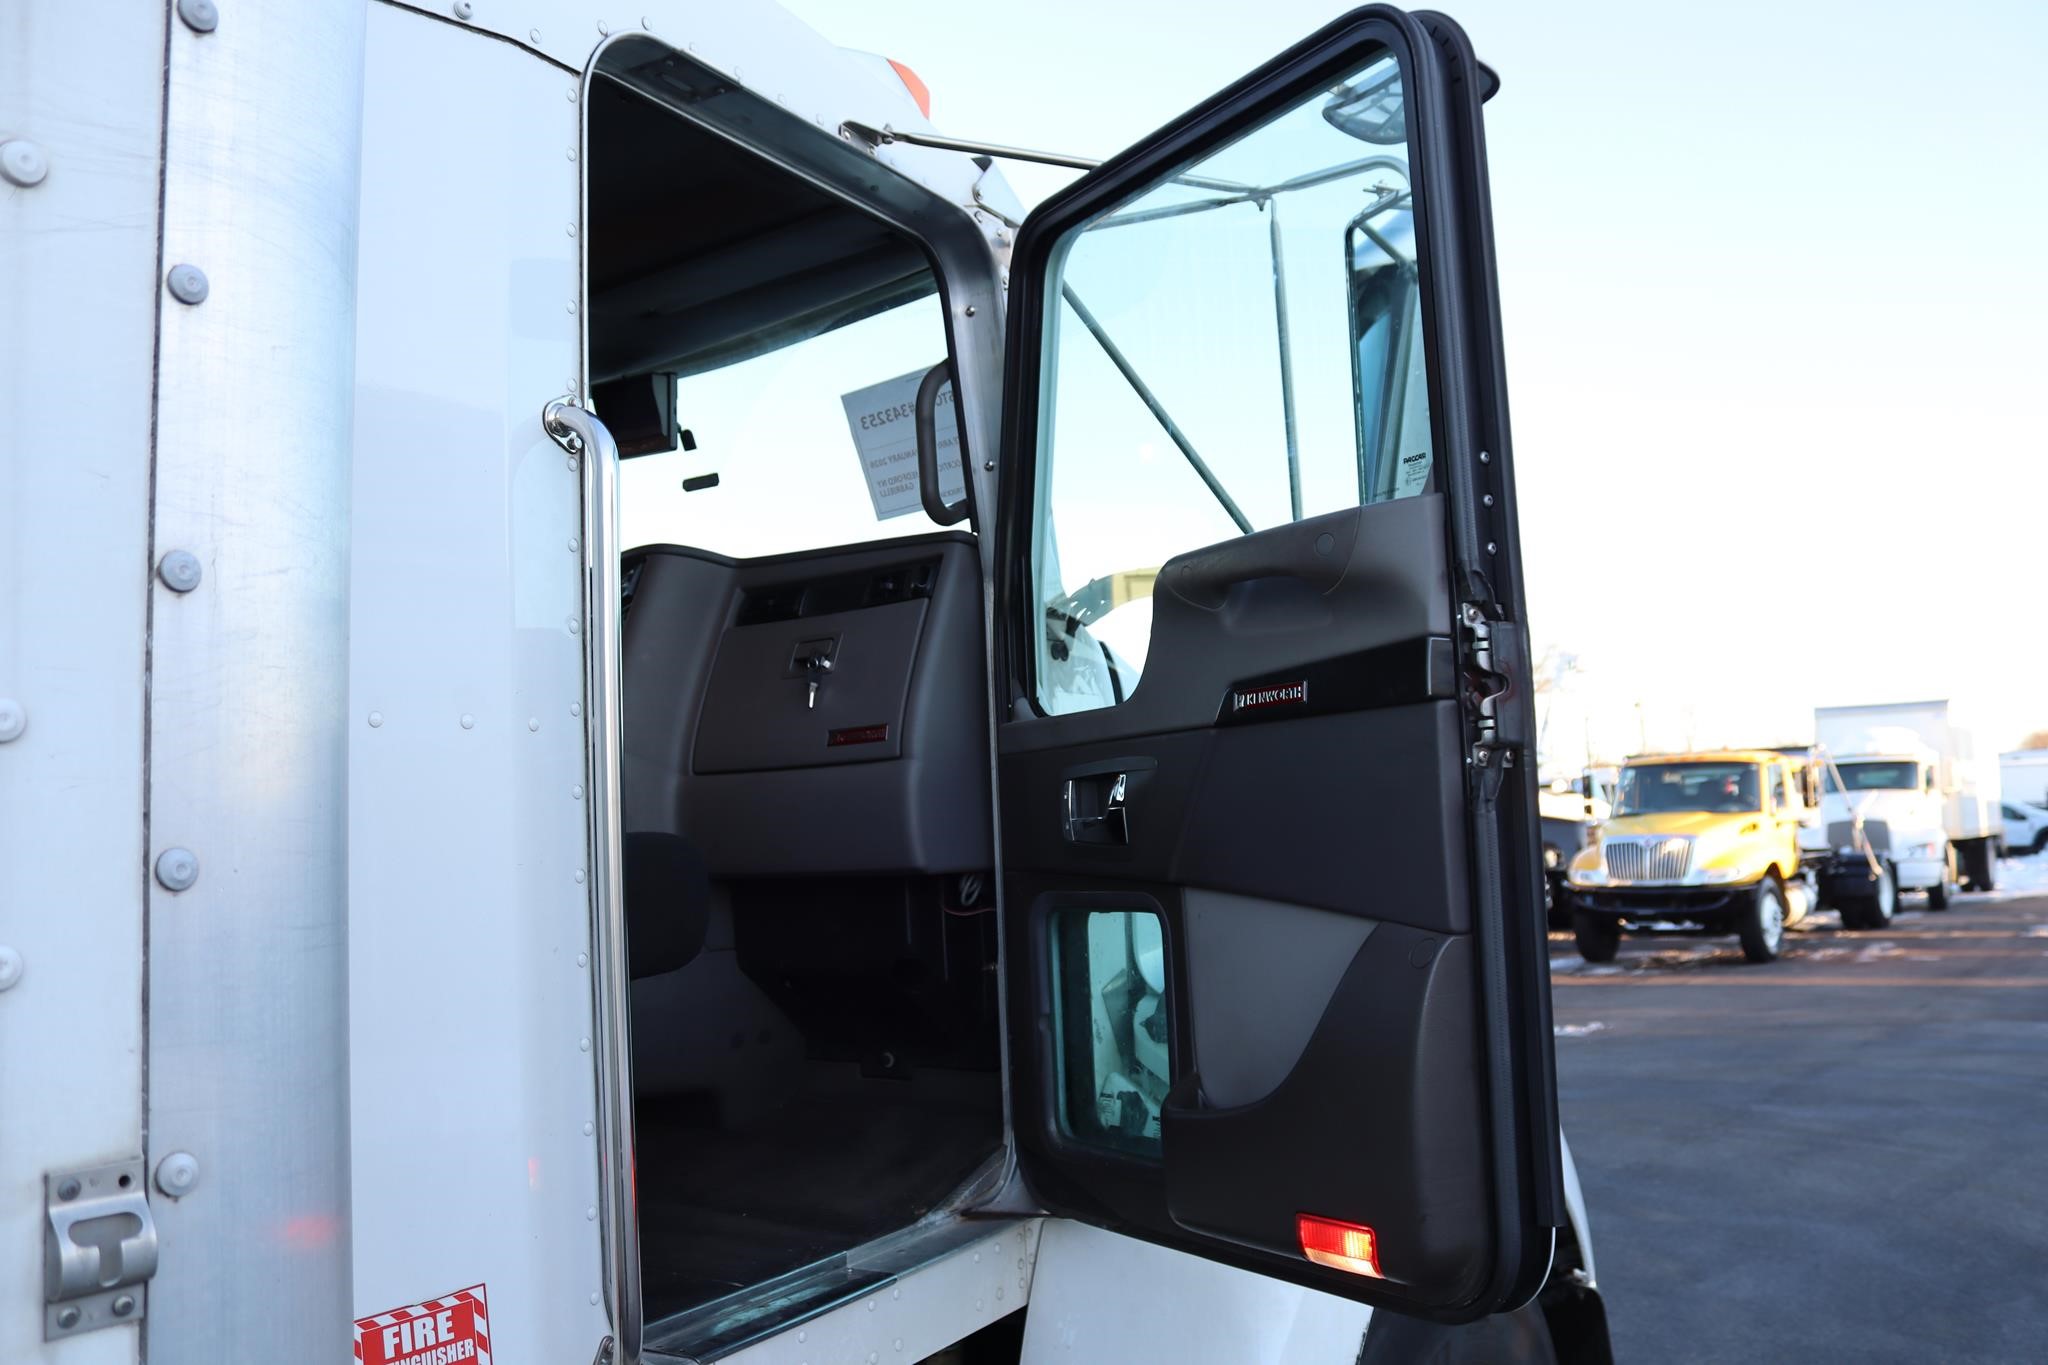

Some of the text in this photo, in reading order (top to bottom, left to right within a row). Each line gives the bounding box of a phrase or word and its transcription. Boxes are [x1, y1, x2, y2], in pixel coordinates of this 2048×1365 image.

[1403, 453, 1426, 464] PACCAR
[1246, 686, 1302, 706] KENWORTH
[382, 1309, 455, 1360] FIRE
